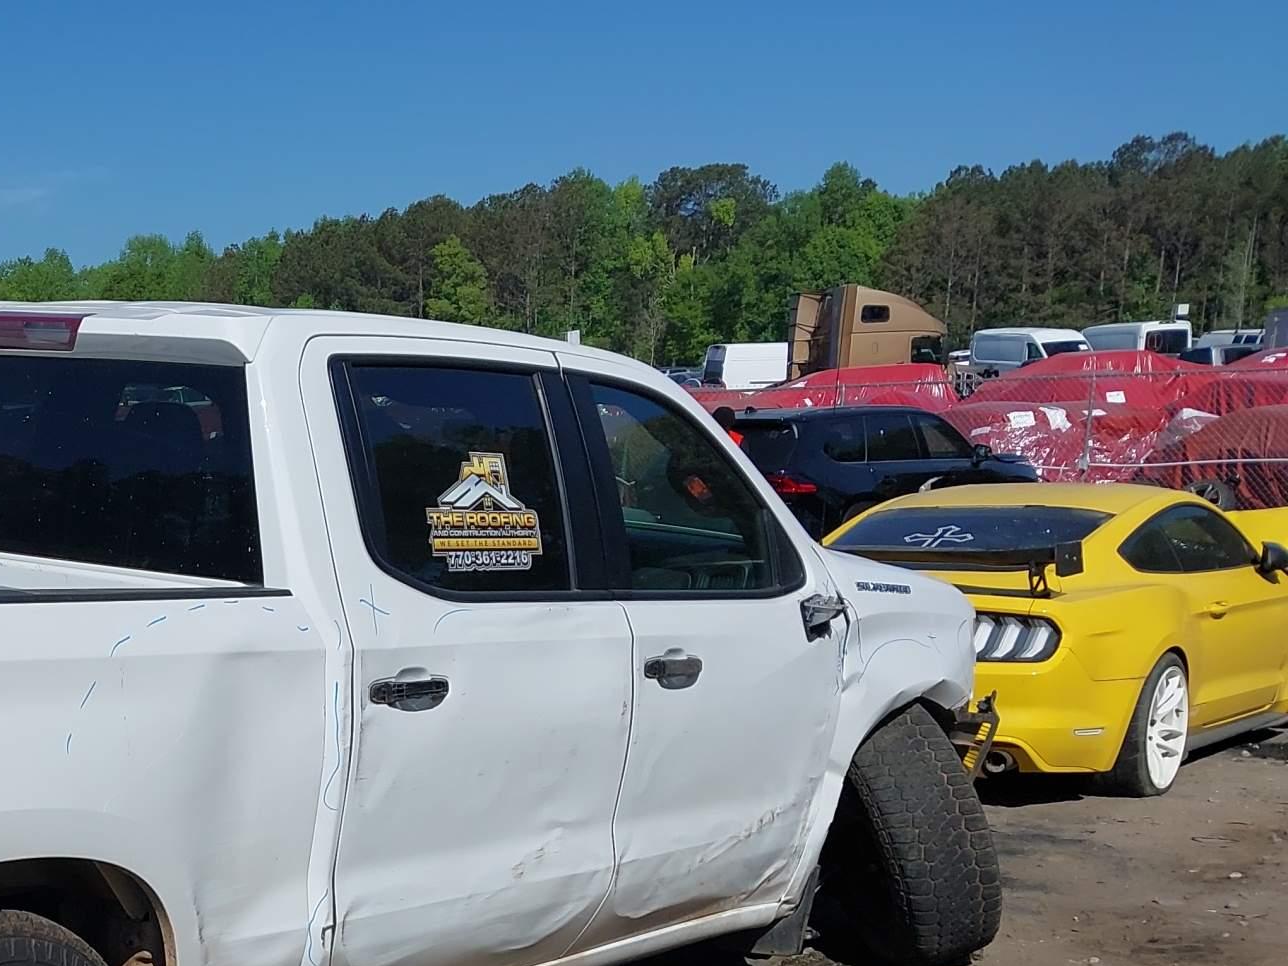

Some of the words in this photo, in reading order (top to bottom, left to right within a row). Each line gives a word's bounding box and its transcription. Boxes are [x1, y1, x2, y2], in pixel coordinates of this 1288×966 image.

[431, 512, 462, 526] THE
[467, 513, 536, 528] ROOFING
[502, 530, 537, 538] AUTHORITY
[449, 551, 528, 564] 770-361-2216
